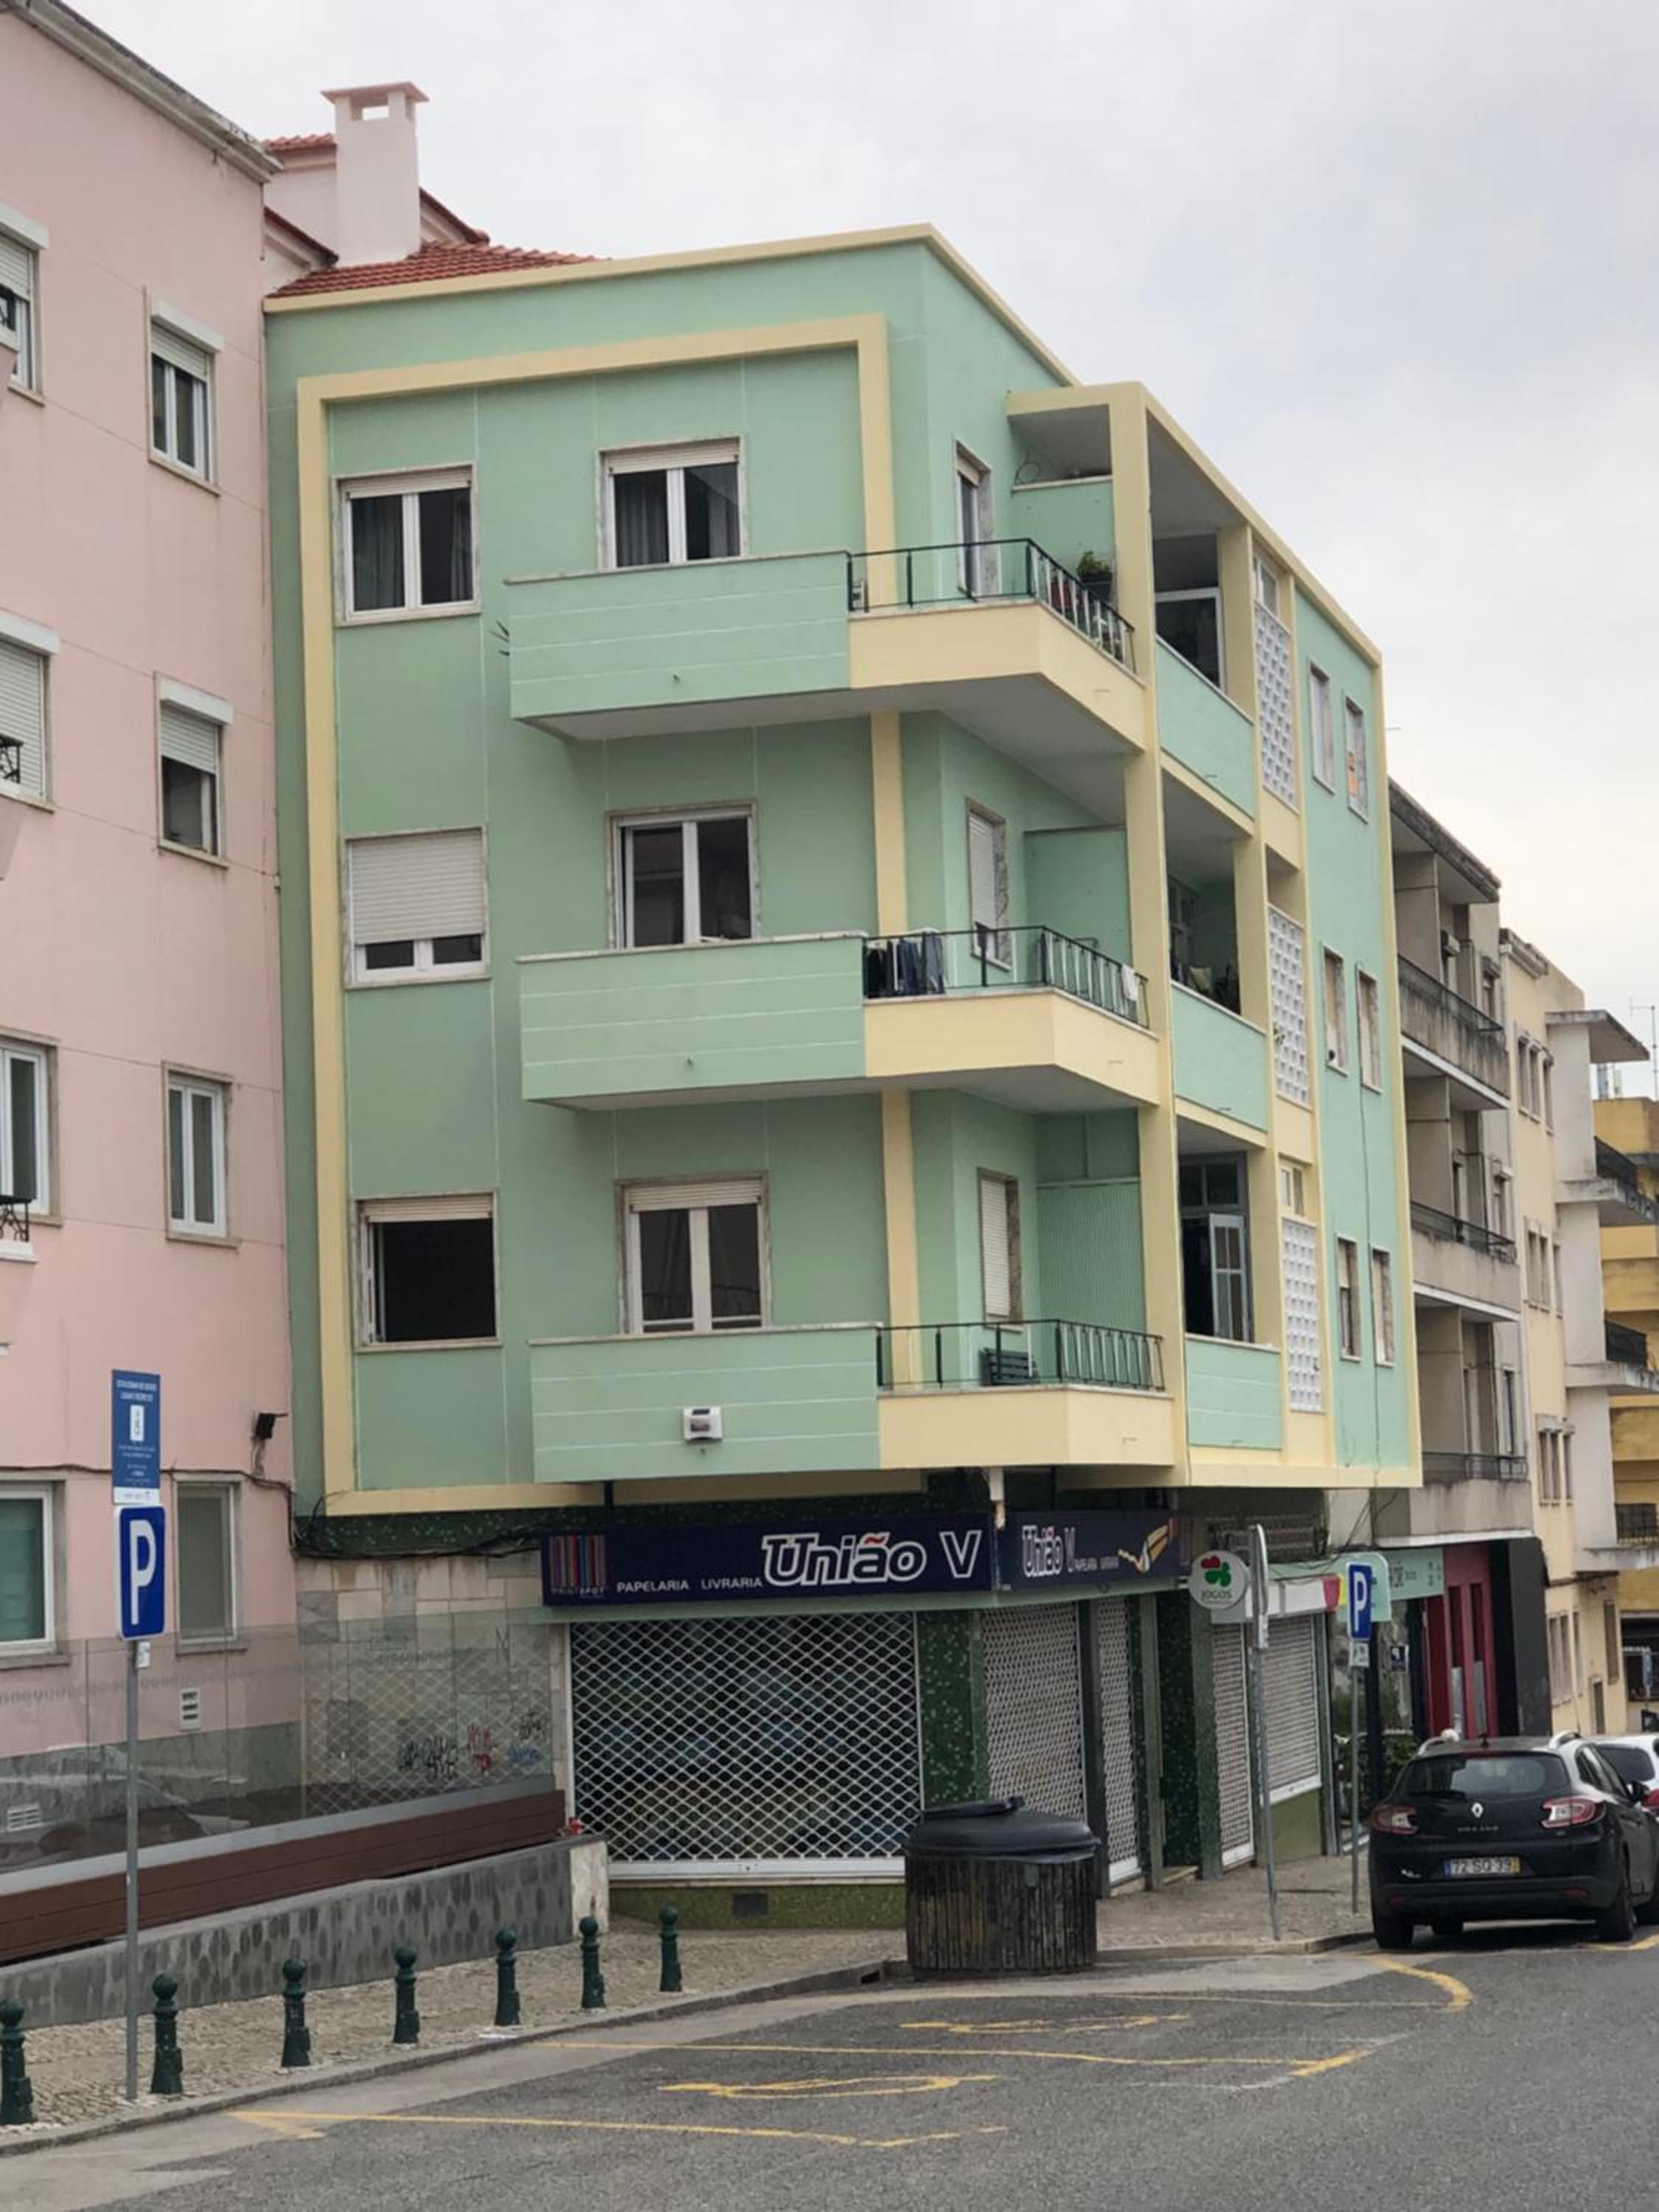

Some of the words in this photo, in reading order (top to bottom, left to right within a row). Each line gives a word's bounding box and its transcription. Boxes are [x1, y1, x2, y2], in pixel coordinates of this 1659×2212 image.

[129, 1519, 156, 1625] P
[762, 1532, 927, 1585] União
[939, 1530, 982, 1578] V
[1022, 1525, 1063, 1577] União
[616, 1580, 689, 1593] PAPELARIA
[701, 1577, 762, 1590] LIVRARIA
[1354, 1571, 1368, 1632] P
